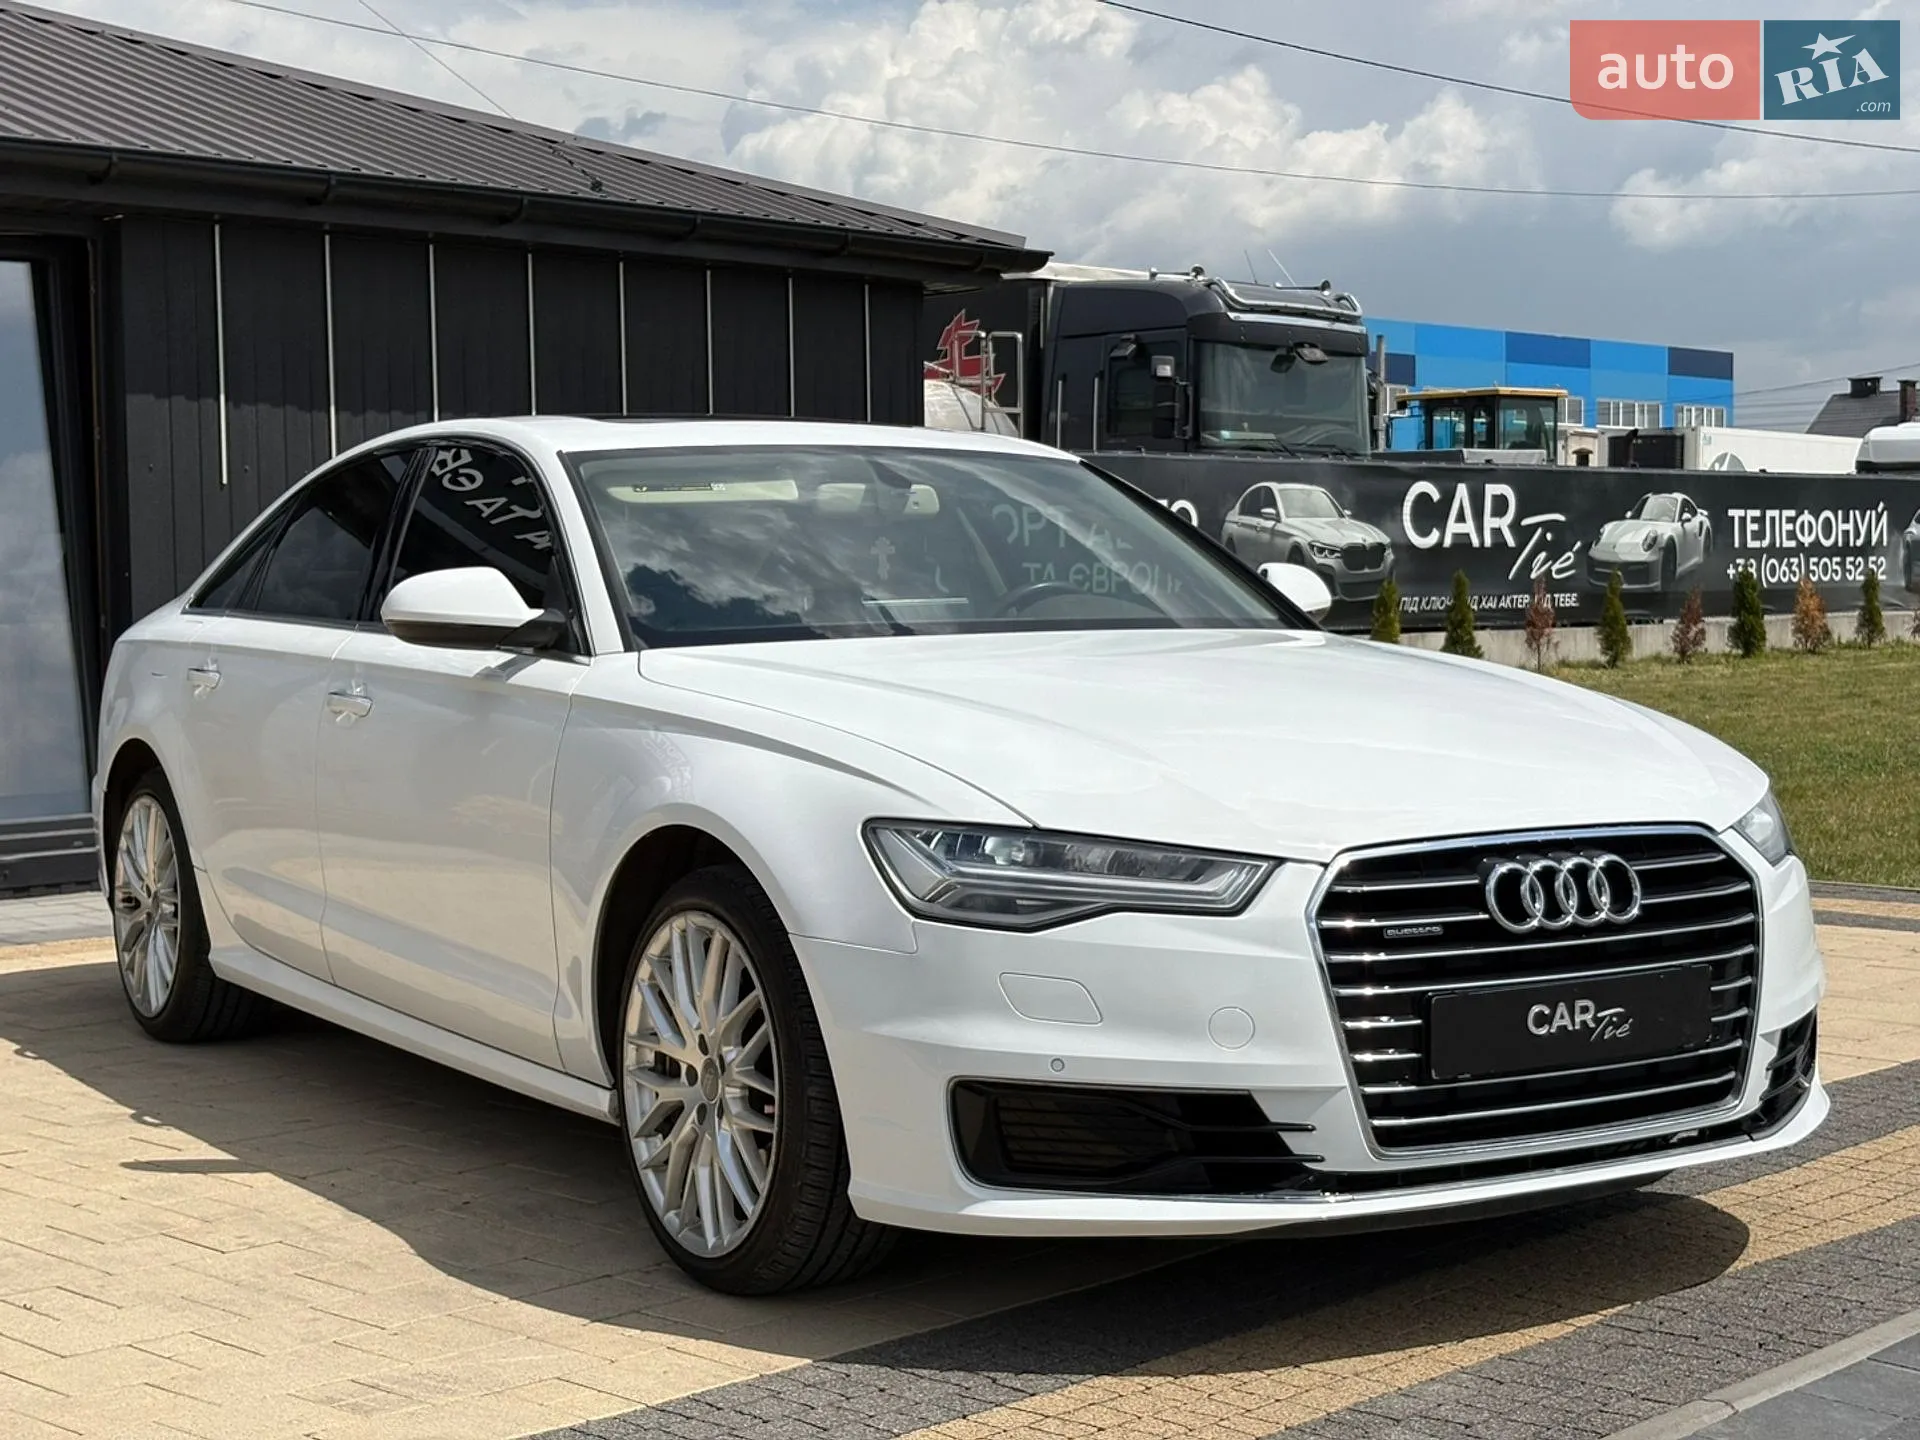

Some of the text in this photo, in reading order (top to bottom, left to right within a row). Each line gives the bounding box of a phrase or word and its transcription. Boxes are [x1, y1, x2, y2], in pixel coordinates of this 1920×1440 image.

[1402, 481, 1516, 549] CAR
[1727, 501, 1888, 548] ТЕЛЕФОНУЙ
[1761, 553, 1805, 588] (063)
[1809, 557, 1841, 582] 505
[1845, 556, 1865, 581] 52
[1527, 998, 1596, 1036] CAR
